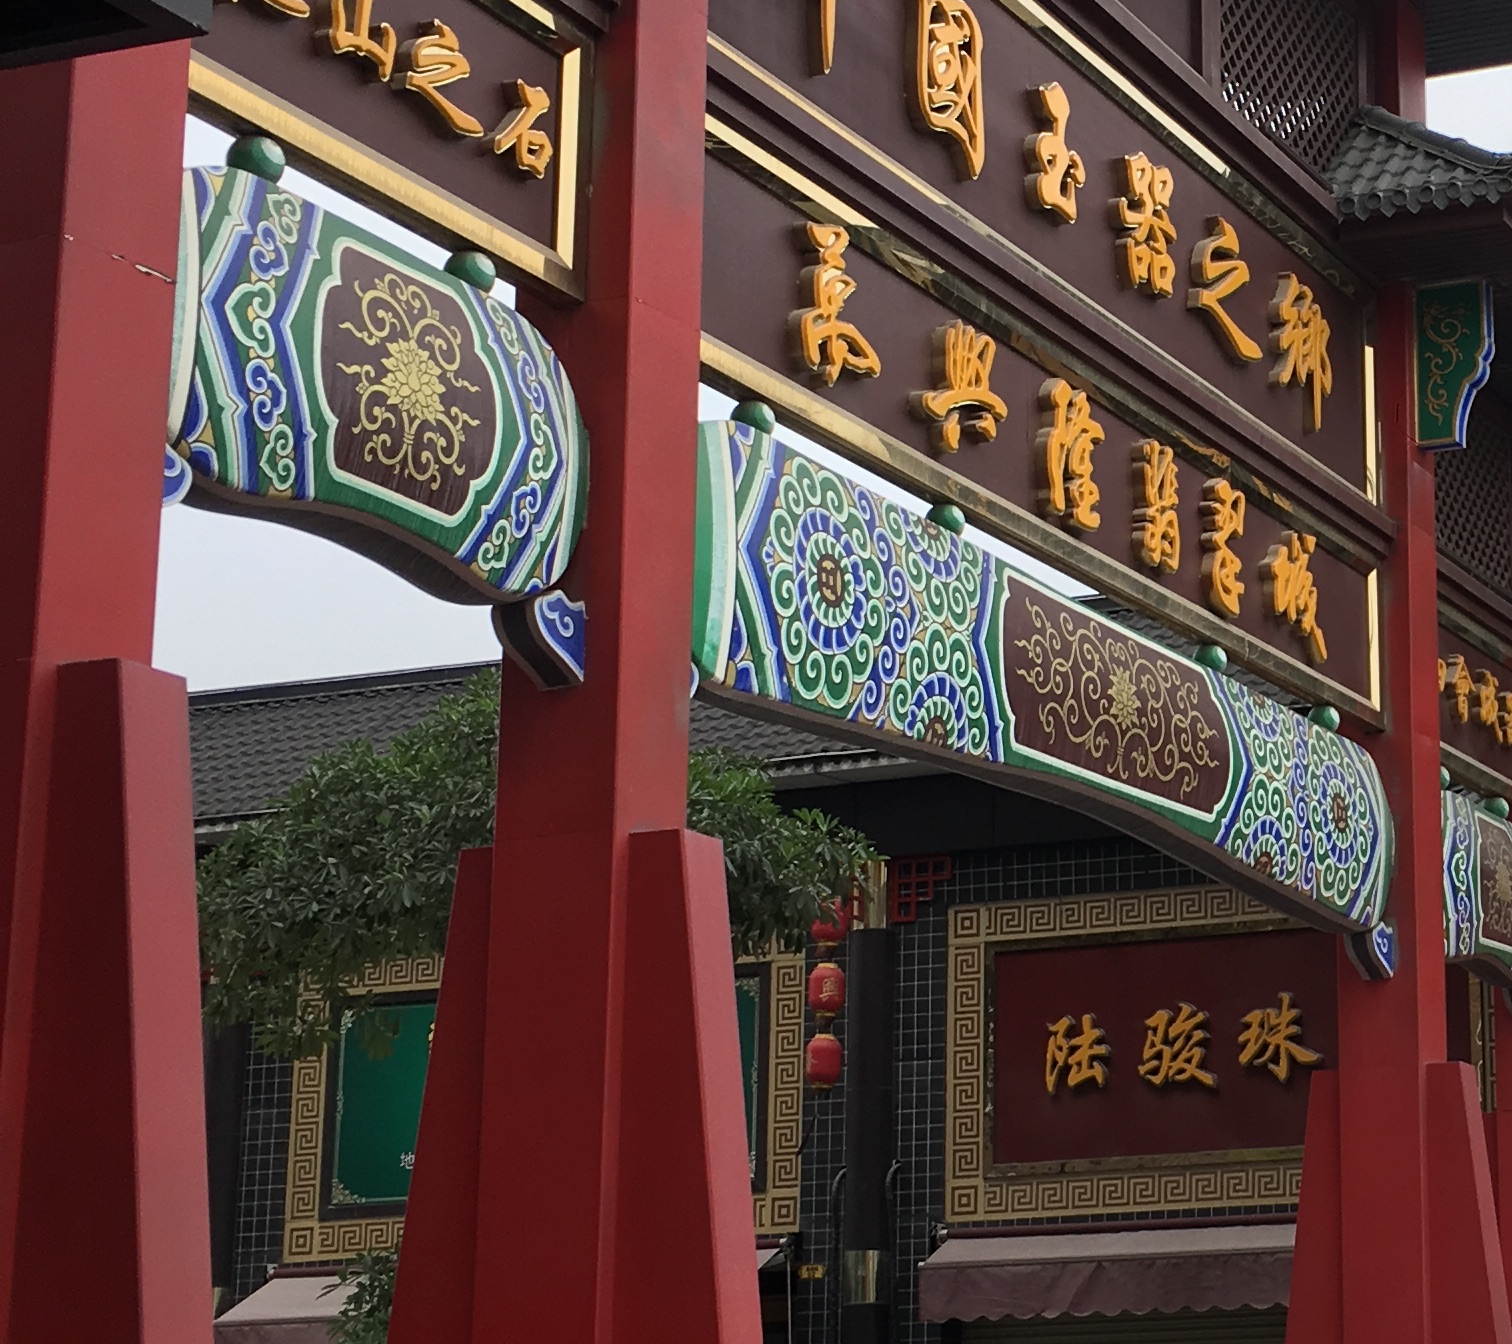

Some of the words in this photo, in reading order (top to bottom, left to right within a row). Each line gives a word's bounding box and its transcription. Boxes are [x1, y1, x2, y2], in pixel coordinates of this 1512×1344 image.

[789, 221, 1328, 663] 萬興隆翡翠城
